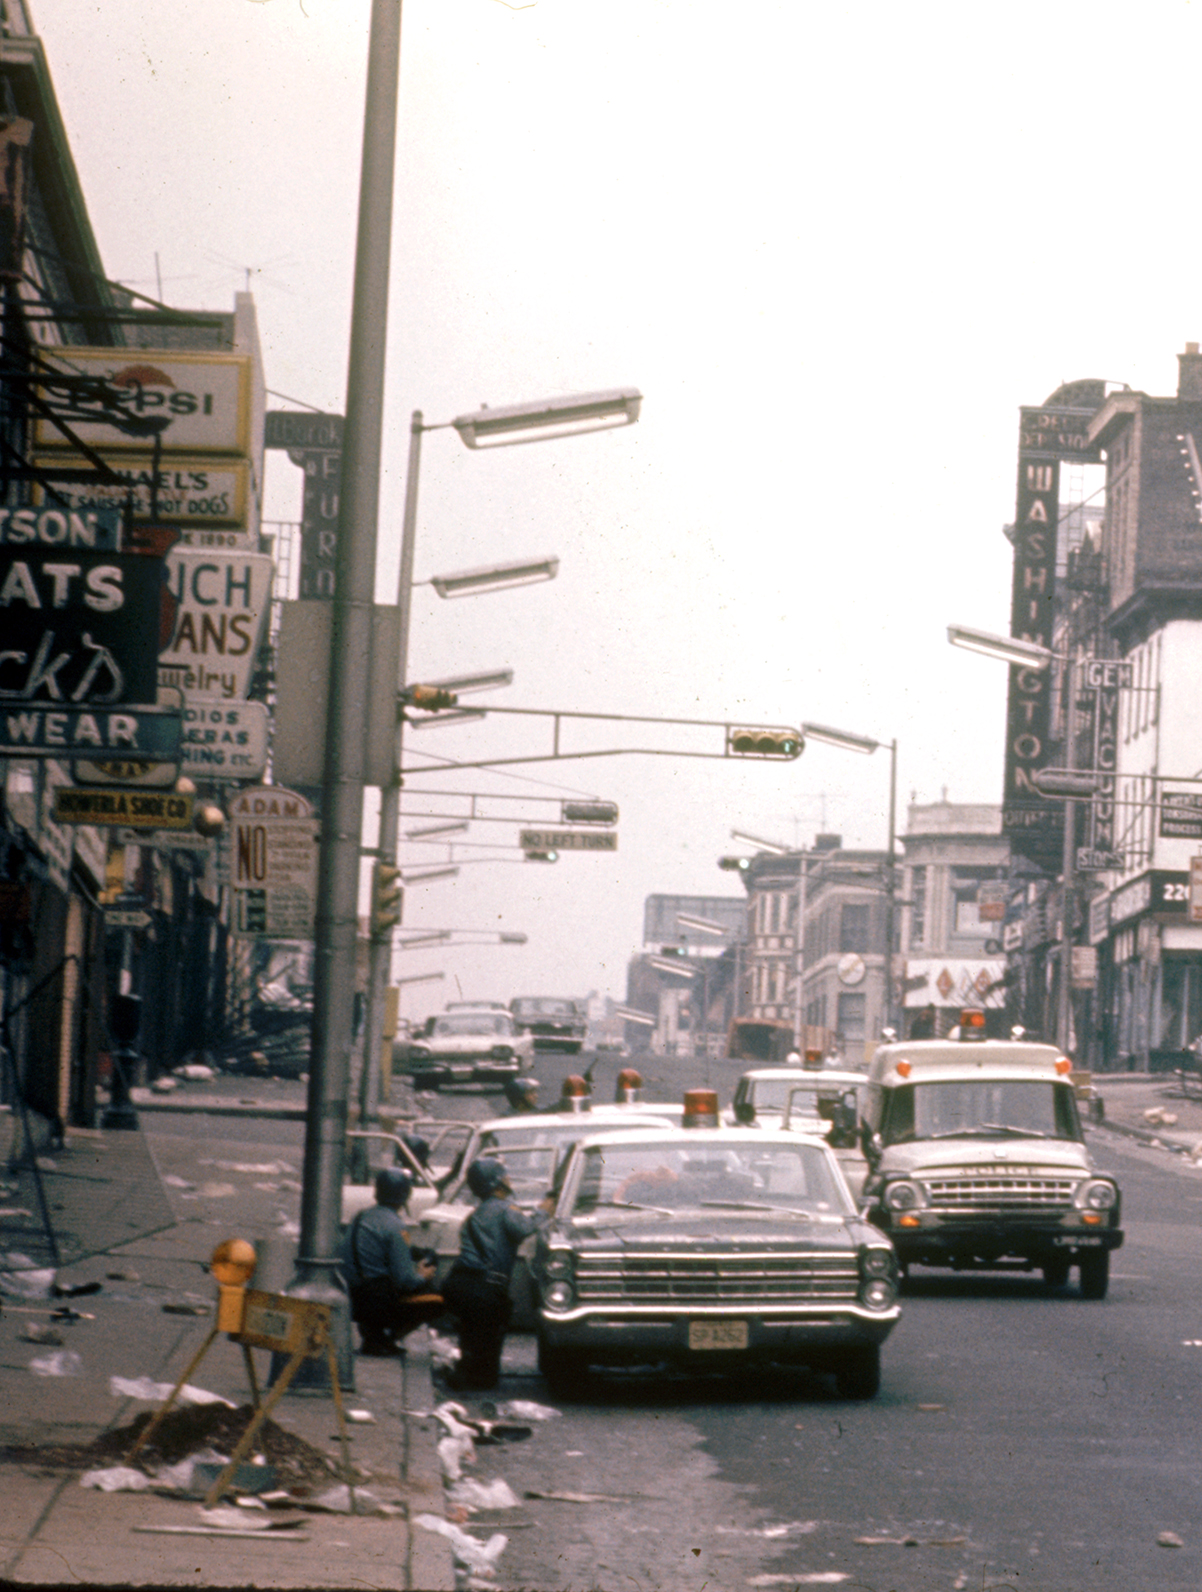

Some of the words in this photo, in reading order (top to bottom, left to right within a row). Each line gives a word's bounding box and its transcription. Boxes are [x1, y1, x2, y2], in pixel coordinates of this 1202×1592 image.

[1088, 662, 1132, 688] GEM
[5, 711, 140, 749] WEAR
[239, 798, 300, 816] ADAM
[237, 824, 267, 881] NO
[522, 833, 542, 847] NO
[546, 833, 575, 847] LEFT
[581, 834, 614, 848] TURN
